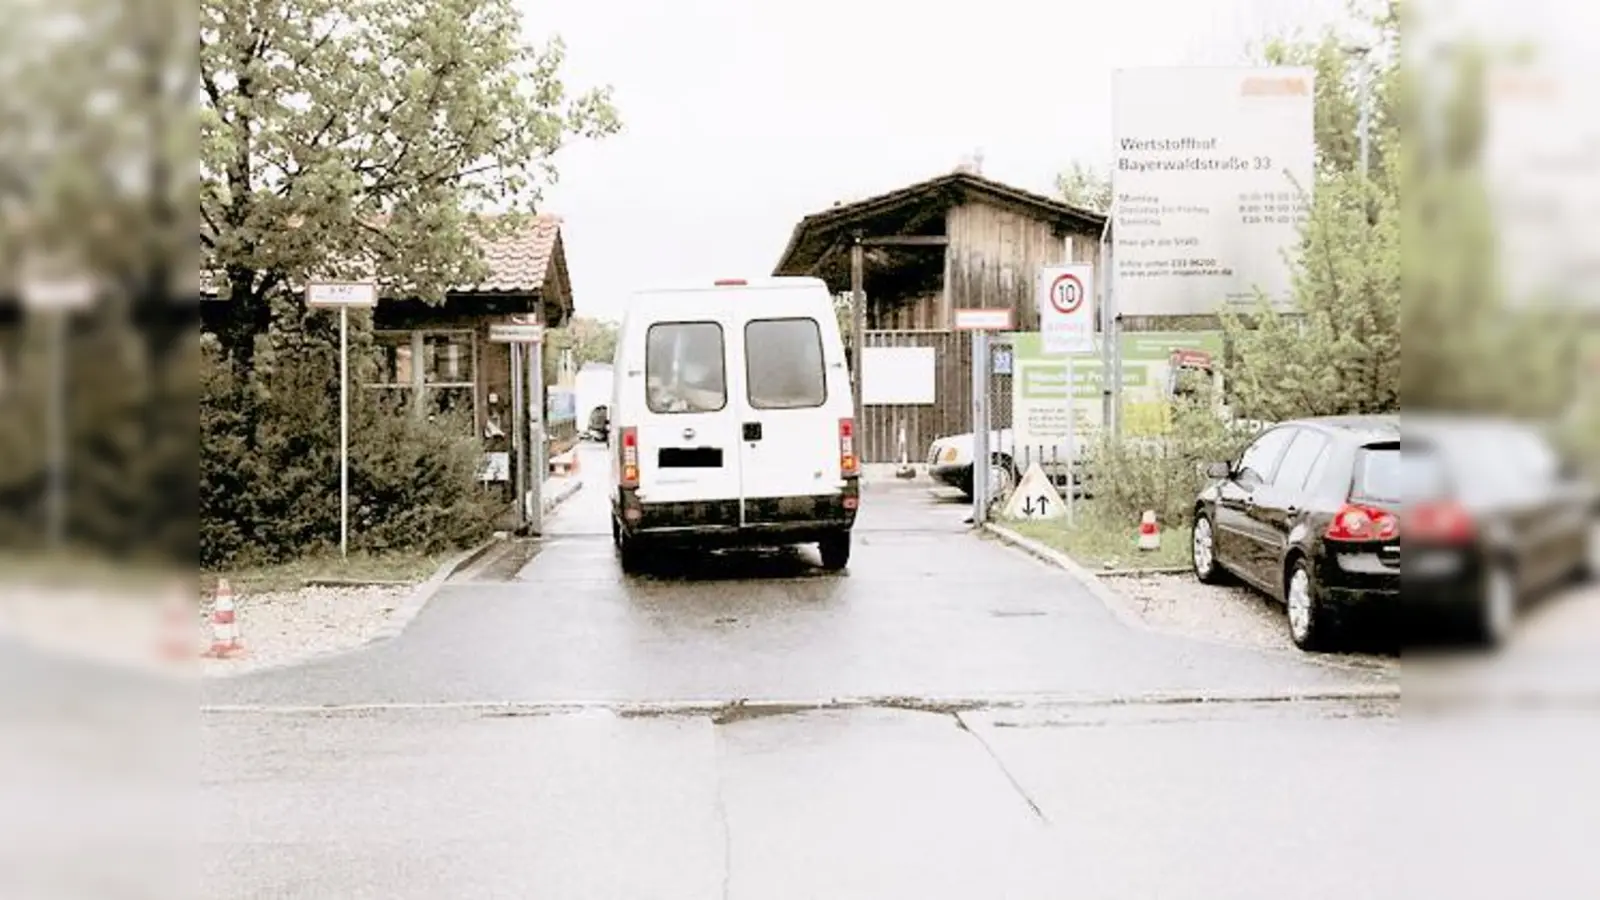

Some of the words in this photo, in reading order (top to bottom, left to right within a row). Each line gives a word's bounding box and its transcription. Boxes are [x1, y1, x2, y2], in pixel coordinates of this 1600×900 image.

[1120, 137, 1217, 151] Wertstoffhof
[1118, 156, 1250, 173] Bayerwaldstraße
[1254, 155, 1272, 170] 33
[1058, 284, 1076, 303] 10
